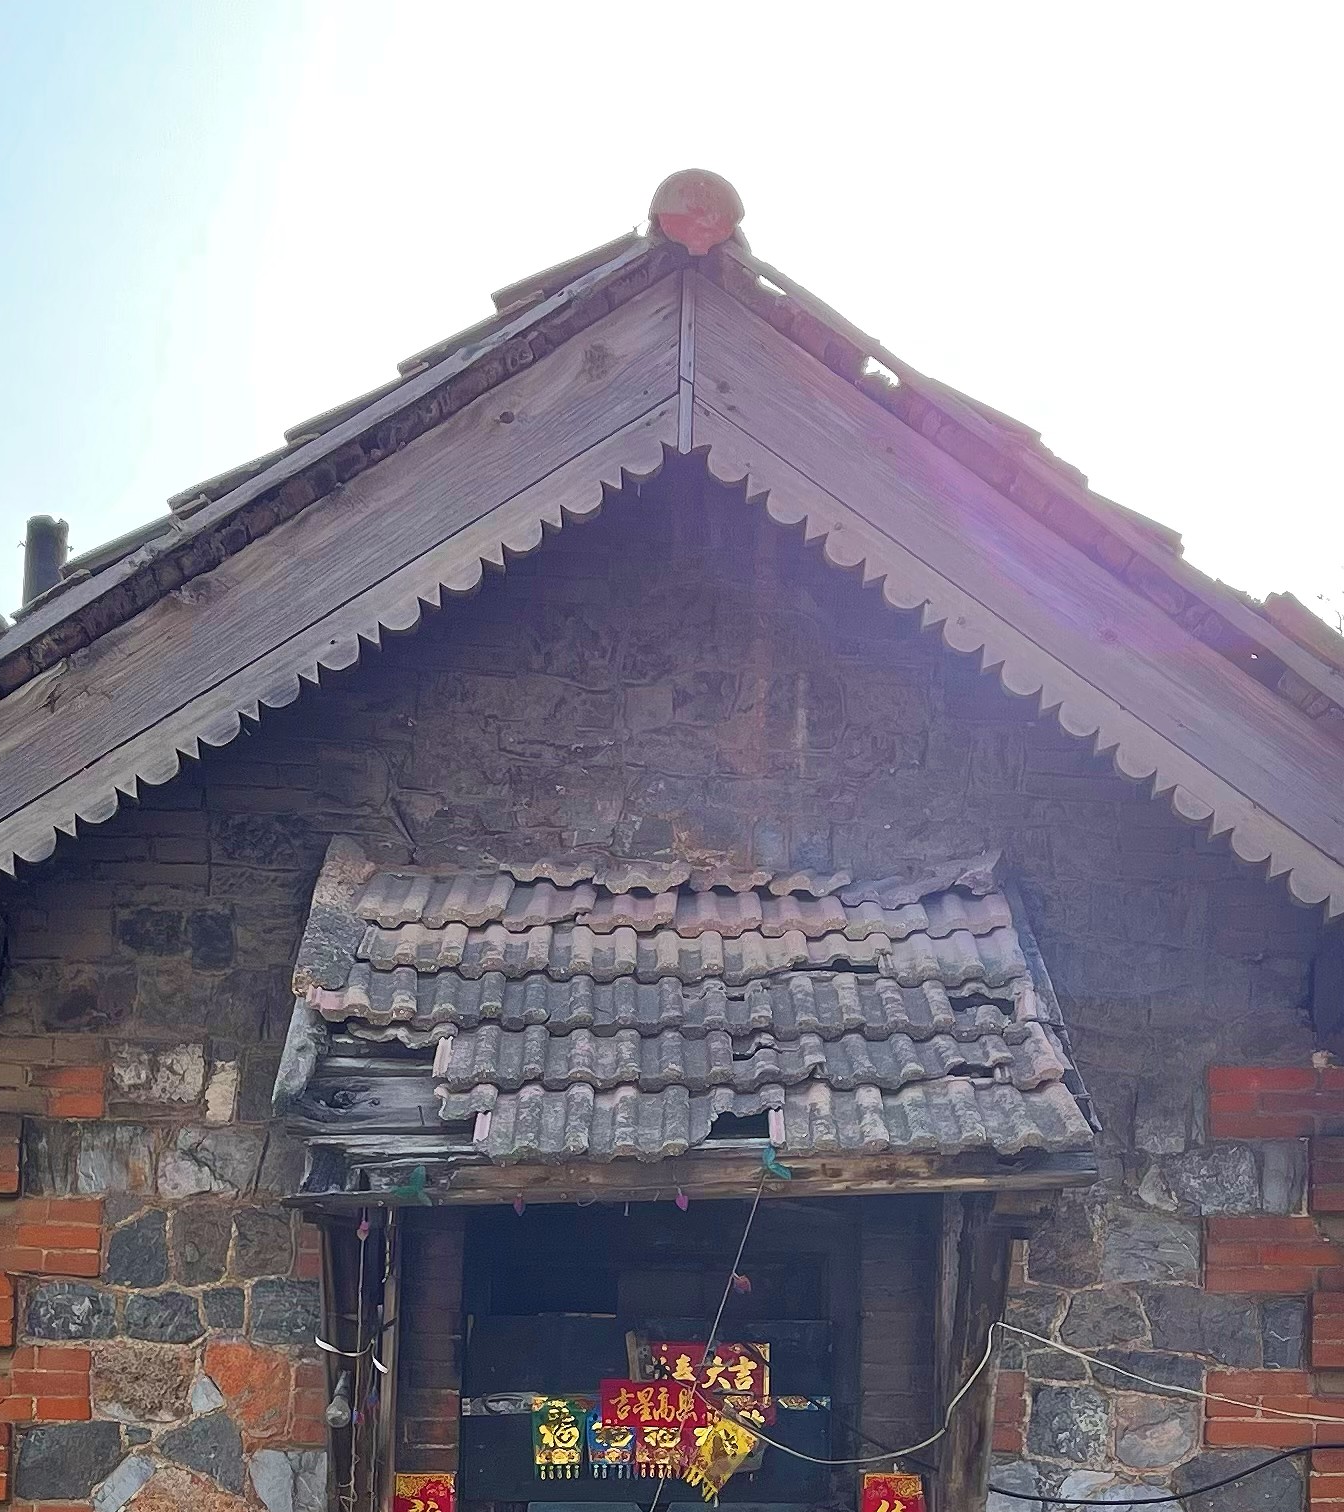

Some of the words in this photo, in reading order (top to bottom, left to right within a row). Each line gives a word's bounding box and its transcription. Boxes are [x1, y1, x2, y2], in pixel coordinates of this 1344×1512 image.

[645, 1354, 758, 1391] 大吉
[609, 1386, 698, 1423] 吉星高照
